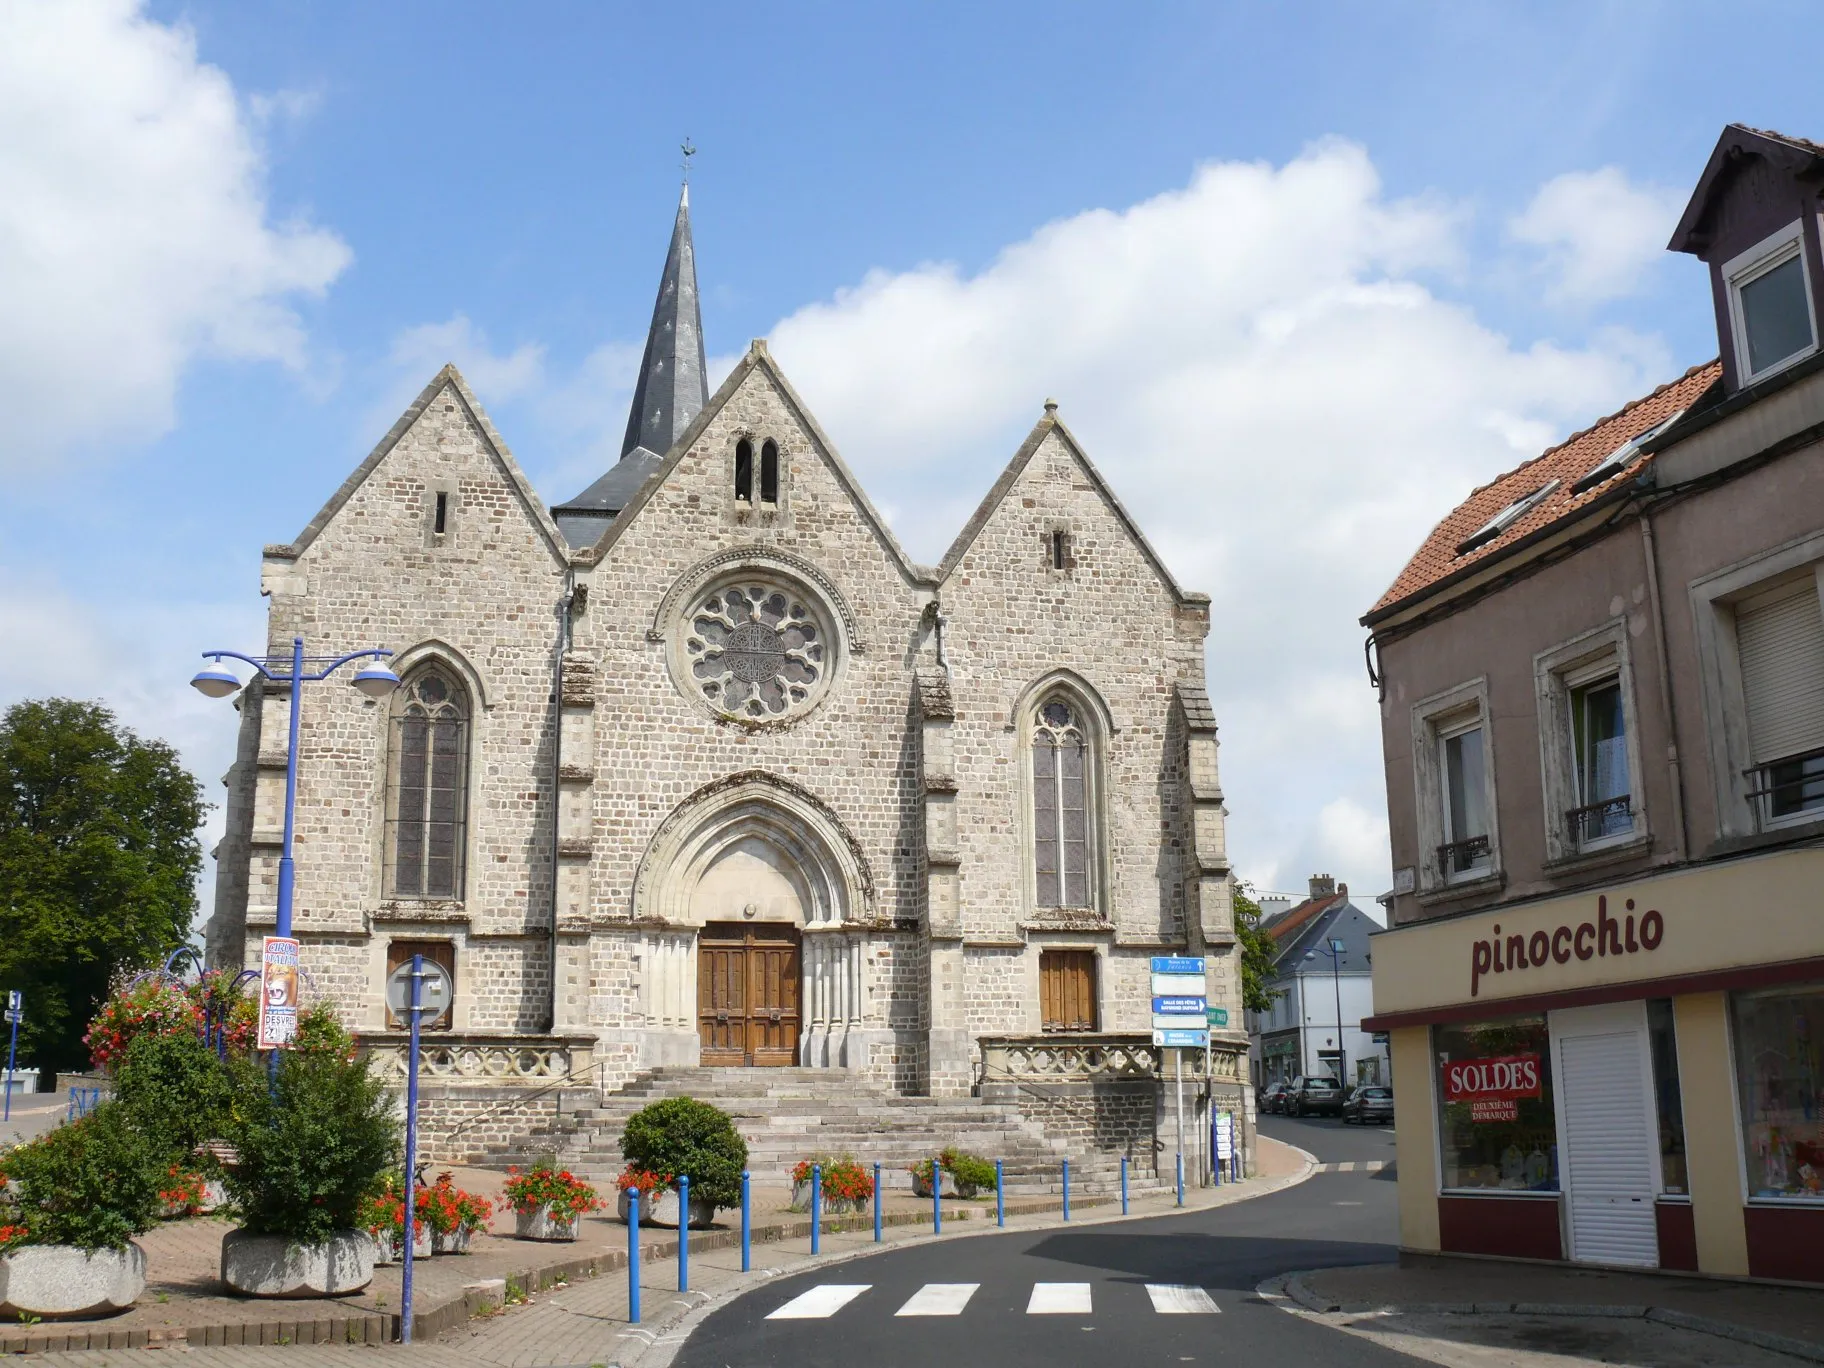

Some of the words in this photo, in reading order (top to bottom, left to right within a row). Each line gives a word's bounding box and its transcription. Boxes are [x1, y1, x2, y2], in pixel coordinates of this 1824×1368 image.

[1471, 895, 1664, 997] pinocchio
[1450, 1061, 1537, 1094] SOLDES
[1473, 1100, 1514, 1111] DEUXIÈME
